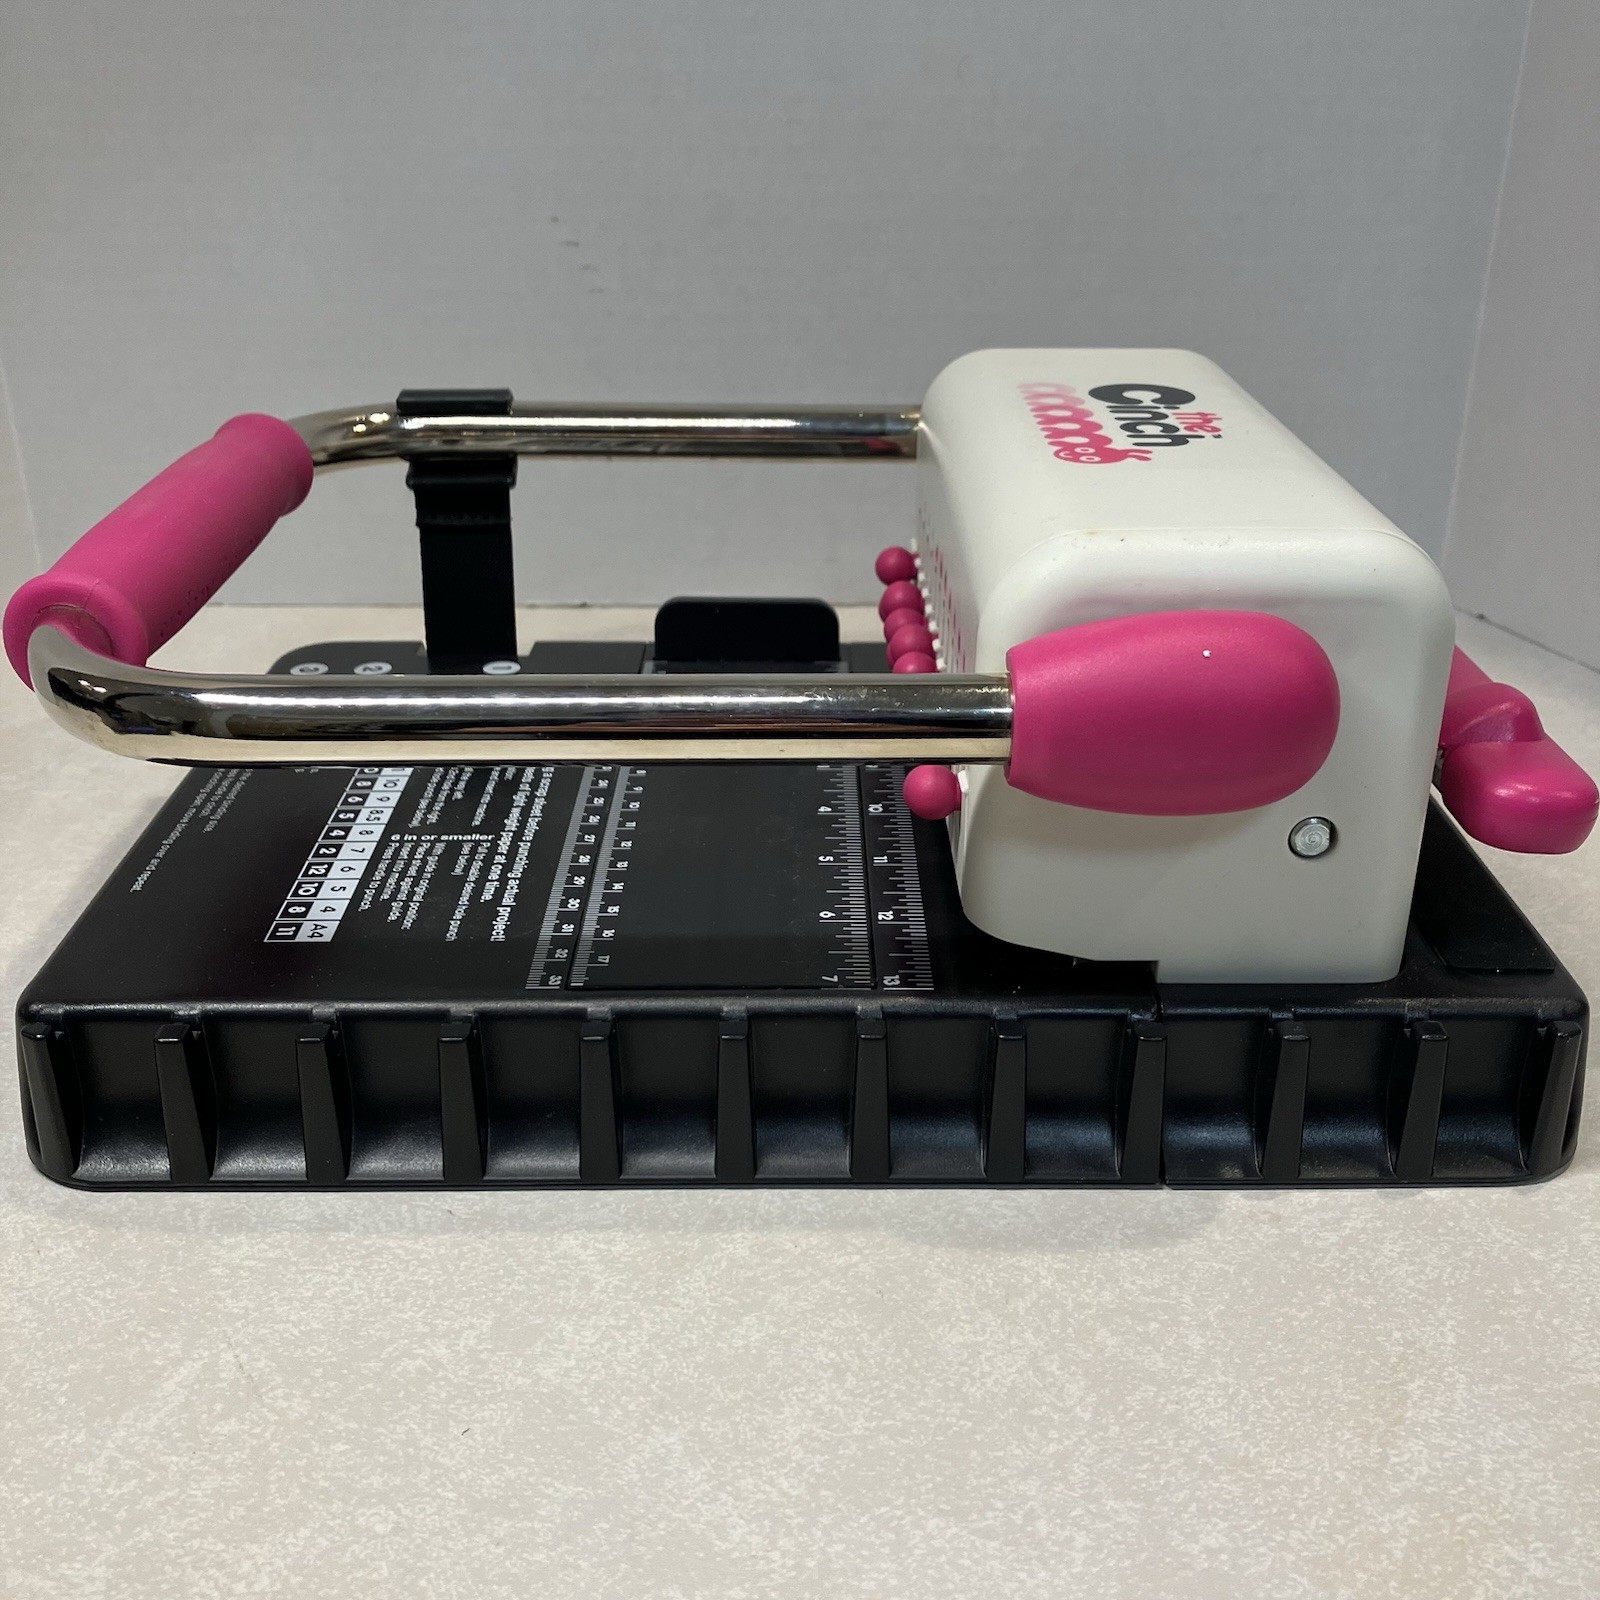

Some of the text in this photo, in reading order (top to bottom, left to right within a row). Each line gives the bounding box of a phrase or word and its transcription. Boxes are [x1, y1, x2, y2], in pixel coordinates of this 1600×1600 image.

[1088, 383, 1205, 447] Cinch
[1172, 411, 1223, 433] the
[384, 779, 400, 788] 10
[519, 783, 531, 791] of
[535, 778, 551, 797] scrap
[598, 779, 609, 787] 24
[513, 791, 530, 807] light
[593, 797, 605, 805] 25
[629, 801, 640, 809] 10
[530, 797, 547, 817] sheet
[868, 804, 883, 813] 10
[180, 808, 196, 823] move
[366, 810, 384, 822] 8.5
[504, 807, 522, 831] weight
[588, 815, 600, 823] 26
[162, 823, 188, 844] binding
[522, 817, 542, 841] before
[404, 833, 418, 841] in
[440, 833, 496, 841] smaller
[497, 832, 514, 854] paper
[584, 834, 596, 843] 27
[620, 840, 632, 848] 12
[155, 844, 170, 858] over
[145, 858, 160, 870] and
[424, 855, 439, 872] guide
[451, 855, 470, 876] below)
[494, 854, 507, 863] at
[507, 842, 531, 878] punching
[578, 855, 591, 863] 28
[308, 864, 329, 875] 12
[380, 842, 415, 901] Insert into machine.
[467, 860, 484, 882] disable
[488, 864, 503, 880] one
[129, 871, 152, 893] repeat.
[358, 842, 400, 912] Press handle to punch.
[387, 842, 431, 922] Place sheet against guide.
[573, 876, 586, 885] 29
[297, 883, 319, 896] 10
[412, 879, 429, 901] original
[480, 881, 500, 903] time.
[502, 879, 520, 905] actual
[612, 882, 625, 890] 14
[458, 882, 476, 905] desired
[567, 898, 581, 909] 30
[607, 905, 620, 913] 15
[401, 902, 420, 930] position:
[453, 905, 469, 919] hole
[878, 910, 894, 920] 12
[275, 926, 296, 936] 11
[307, 924, 328, 938] A4
[445, 920, 461, 942] punch
[490, 907, 511, 942] project!
[561, 924, 575, 933] 31
[602, 929, 616, 938] 16
[554, 948, 569, 958] 32
[597, 955, 610, 963] 17
[548, 975, 562, 985] 33
[883, 975, 901, 986] 13
